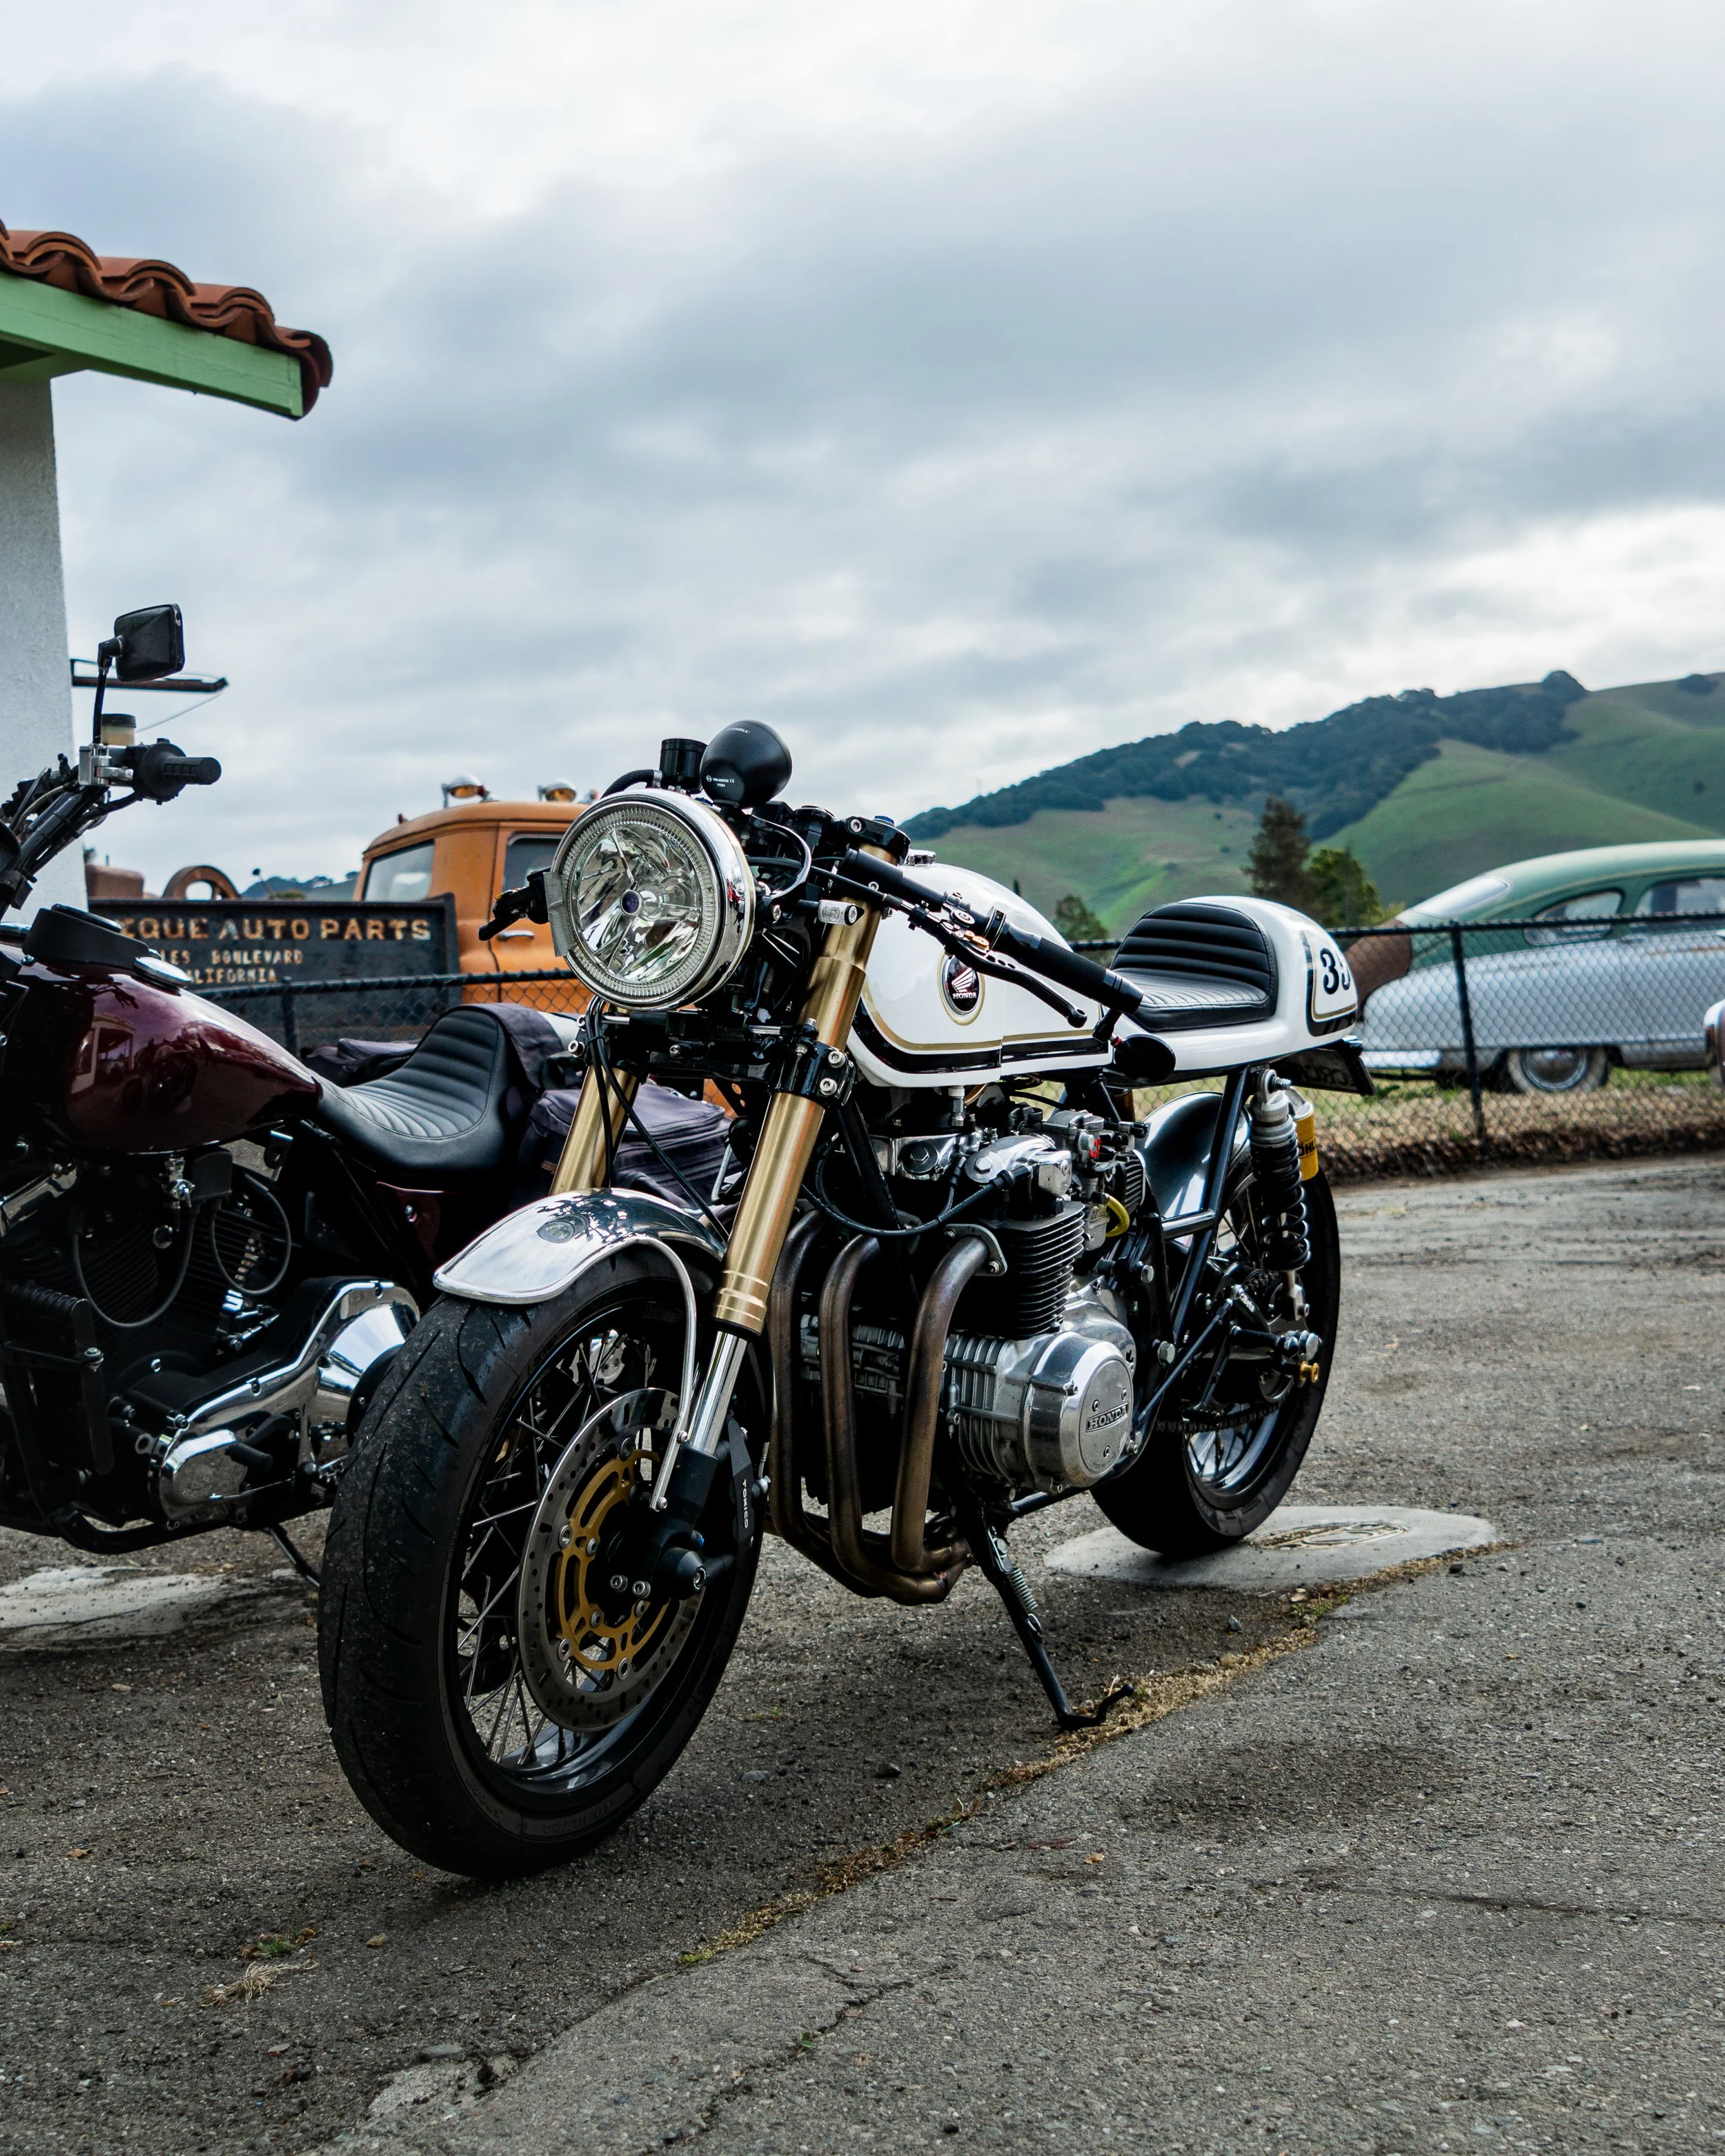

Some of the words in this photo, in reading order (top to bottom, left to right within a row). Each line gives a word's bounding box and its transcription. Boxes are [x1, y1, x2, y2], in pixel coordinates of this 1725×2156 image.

[218, 918, 309, 940] AUTO
[320, 918, 431, 940] PARTS
[211, 949, 304, 965] BOULEVARD
[1088, 1405, 1128, 1430] HONDA
